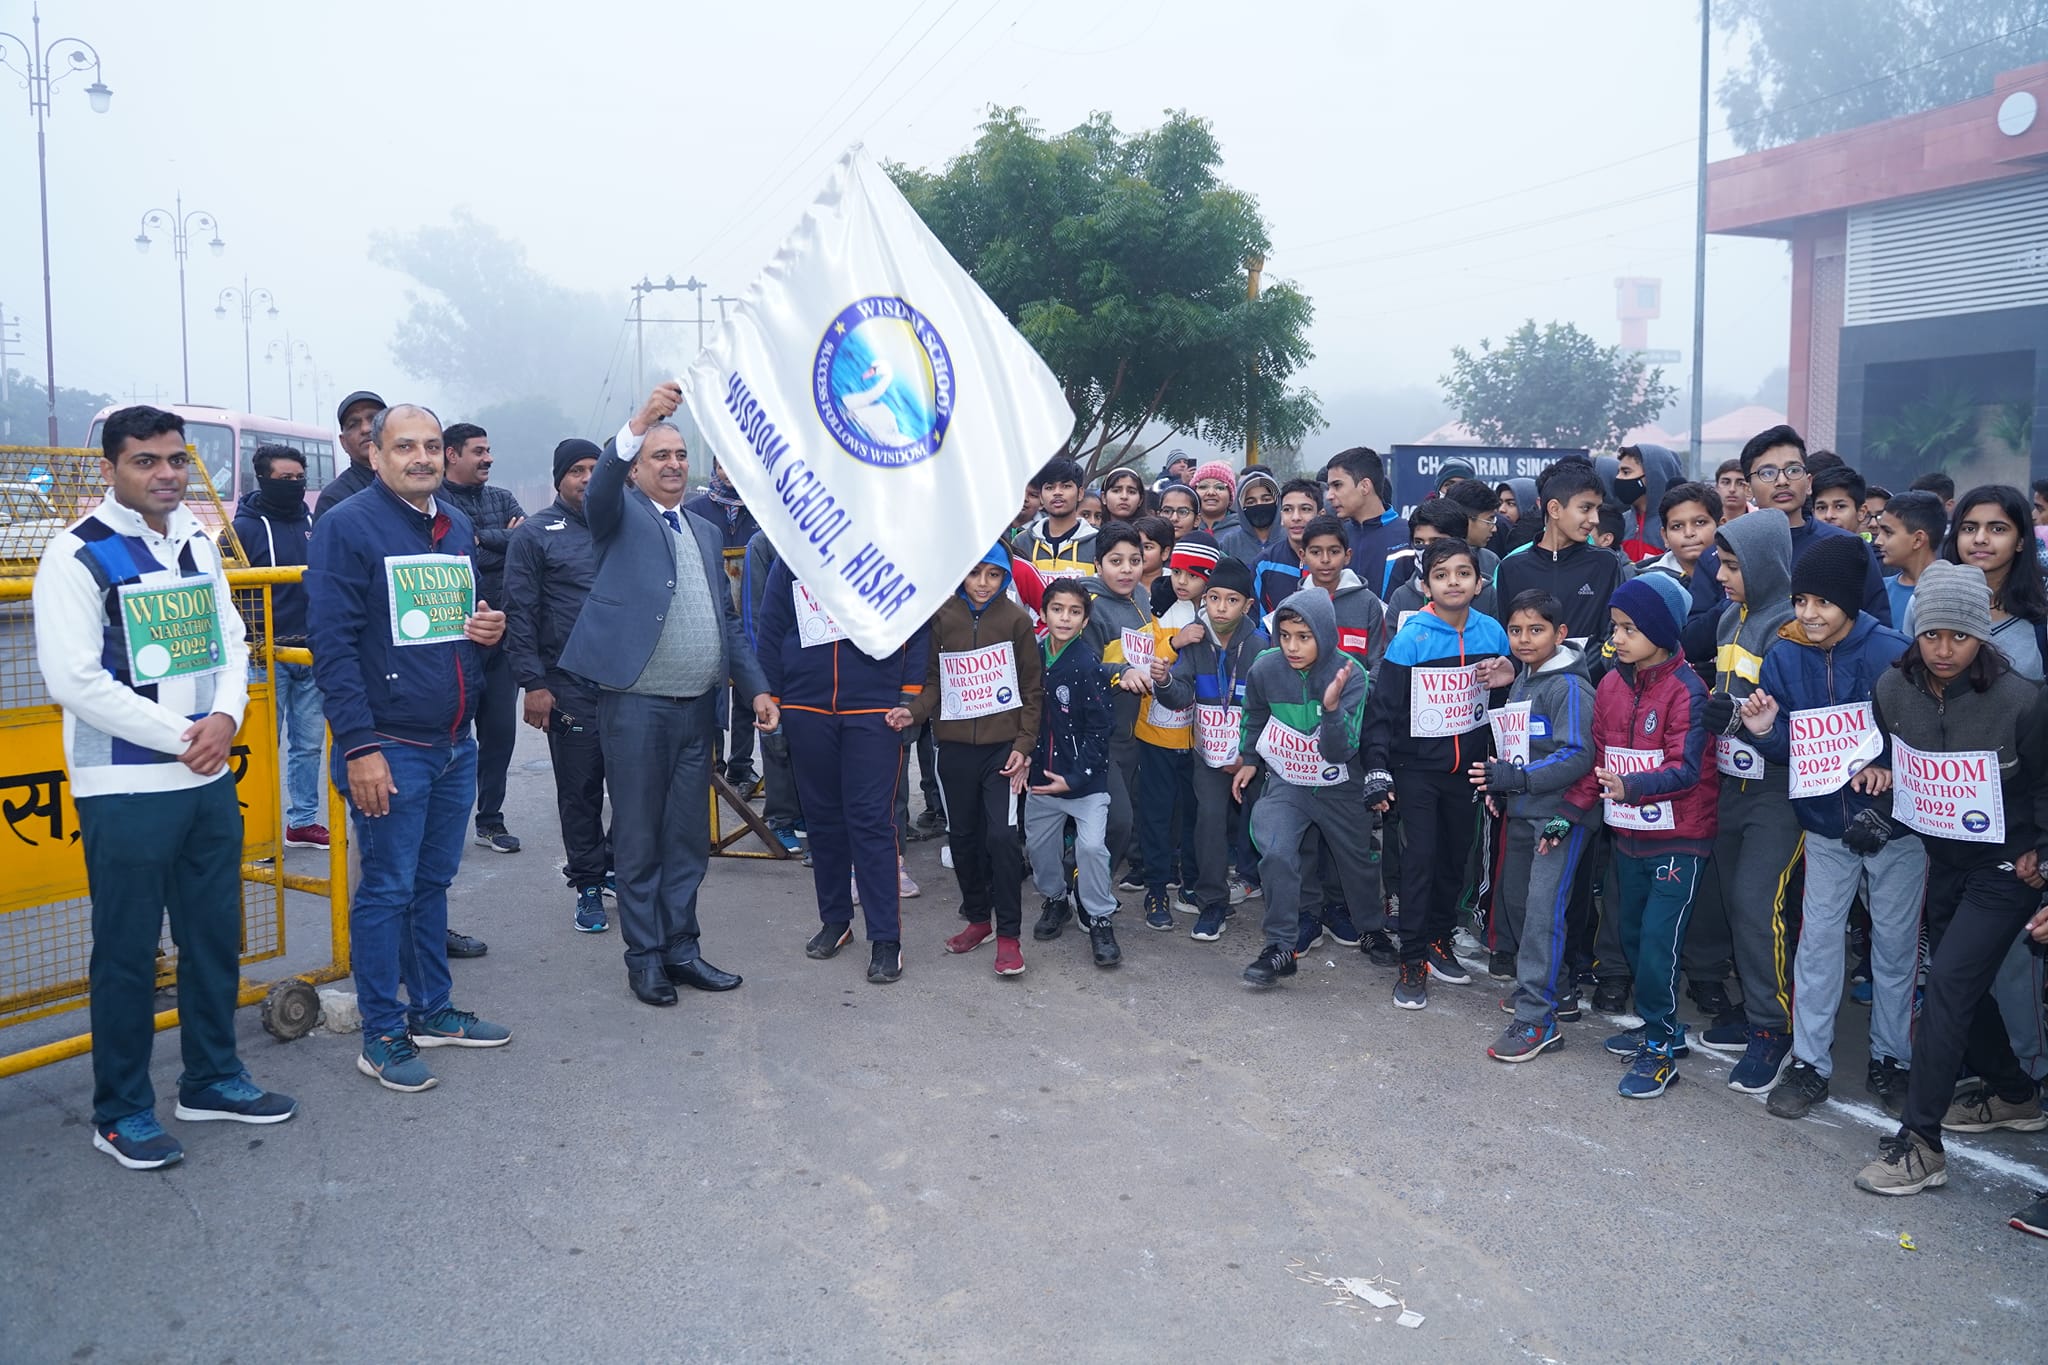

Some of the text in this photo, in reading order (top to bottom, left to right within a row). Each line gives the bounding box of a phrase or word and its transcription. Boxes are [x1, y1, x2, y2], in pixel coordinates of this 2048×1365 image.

[822, 402, 868, 457] FOLLOWS
[870, 442, 927, 465] WISDOM
[725, 371, 790, 476] WISDOM
[775, 458, 853, 569] SCHOOL,
[839, 541, 917, 622] HISAR
[395, 566, 473, 592] WISDOM
[126, 588, 217, 625] WISDOM
[413, 591, 467, 607] MARATHON
[429, 605, 464, 623] 2022
[149, 618, 213, 641] MARATHON
[170, 636, 207, 658] 2022
[944, 648, 1008, 676] WISDOM
[949, 669, 1004, 688] MARATHON
[1420, 669, 1478, 692] WISDO
[961, 685, 993, 702] 2022
[1427, 686, 1482, 705] MARATHON
[965, 701, 993, 712] JUNIOR
[1445, 702, 1474, 719] 2022
[1445, 719, 1472, 729] JUNIOR
[1790, 709, 1867, 742] ISDOM
[1267, 723, 1321, 754] WISDO
[1791, 735, 1859, 757] ARATHON
[1268, 745, 1326, 763] MARATHO
[1896, 743, 1988, 783] WISDOM
[1284, 760, 1319, 775] 2022
[1798, 755, 1842, 776] 2022
[1286, 773, 1317, 781] JUNIOR
[1802, 775, 1841, 788] JUNIOR
[1901, 773, 1977, 799] MARATHON
[1612, 811, 1636, 821] JUNIOR
[1915, 796, 1956, 818] 2022
[1918, 816, 1955, 830] JUNIOR
